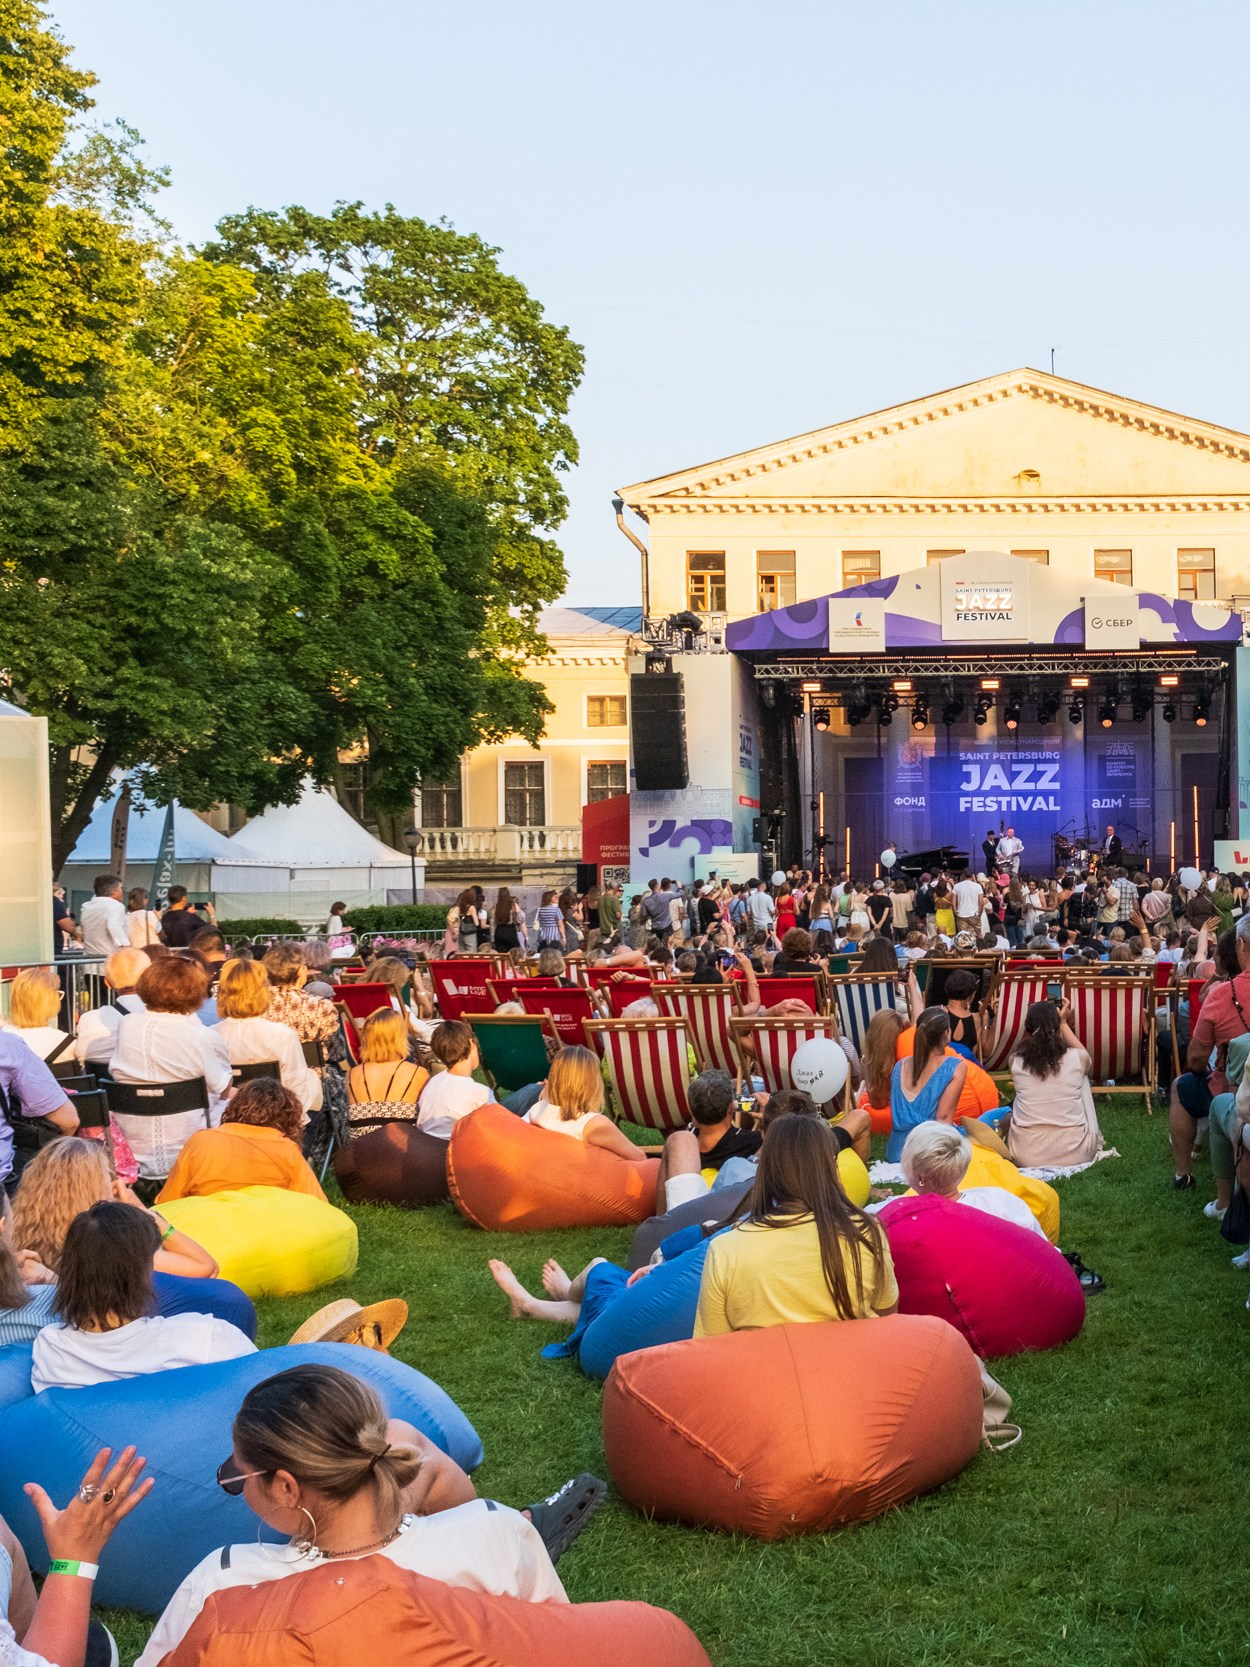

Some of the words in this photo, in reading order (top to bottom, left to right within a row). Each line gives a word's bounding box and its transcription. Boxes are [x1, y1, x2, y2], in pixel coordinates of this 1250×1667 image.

[955, 593, 1013, 611] JAZZ
[956, 612, 1013, 621] FESTIVAL
[1105, 619, 1133, 627] СБЕР
[959, 752, 991, 760] SAINT
[992, 751, 1060, 760] PETERSBURG
[960, 763, 1061, 791] JAZZ
[894, 797, 926, 806] ФОНД
[959, 796, 1061, 812] FESTIVAL
